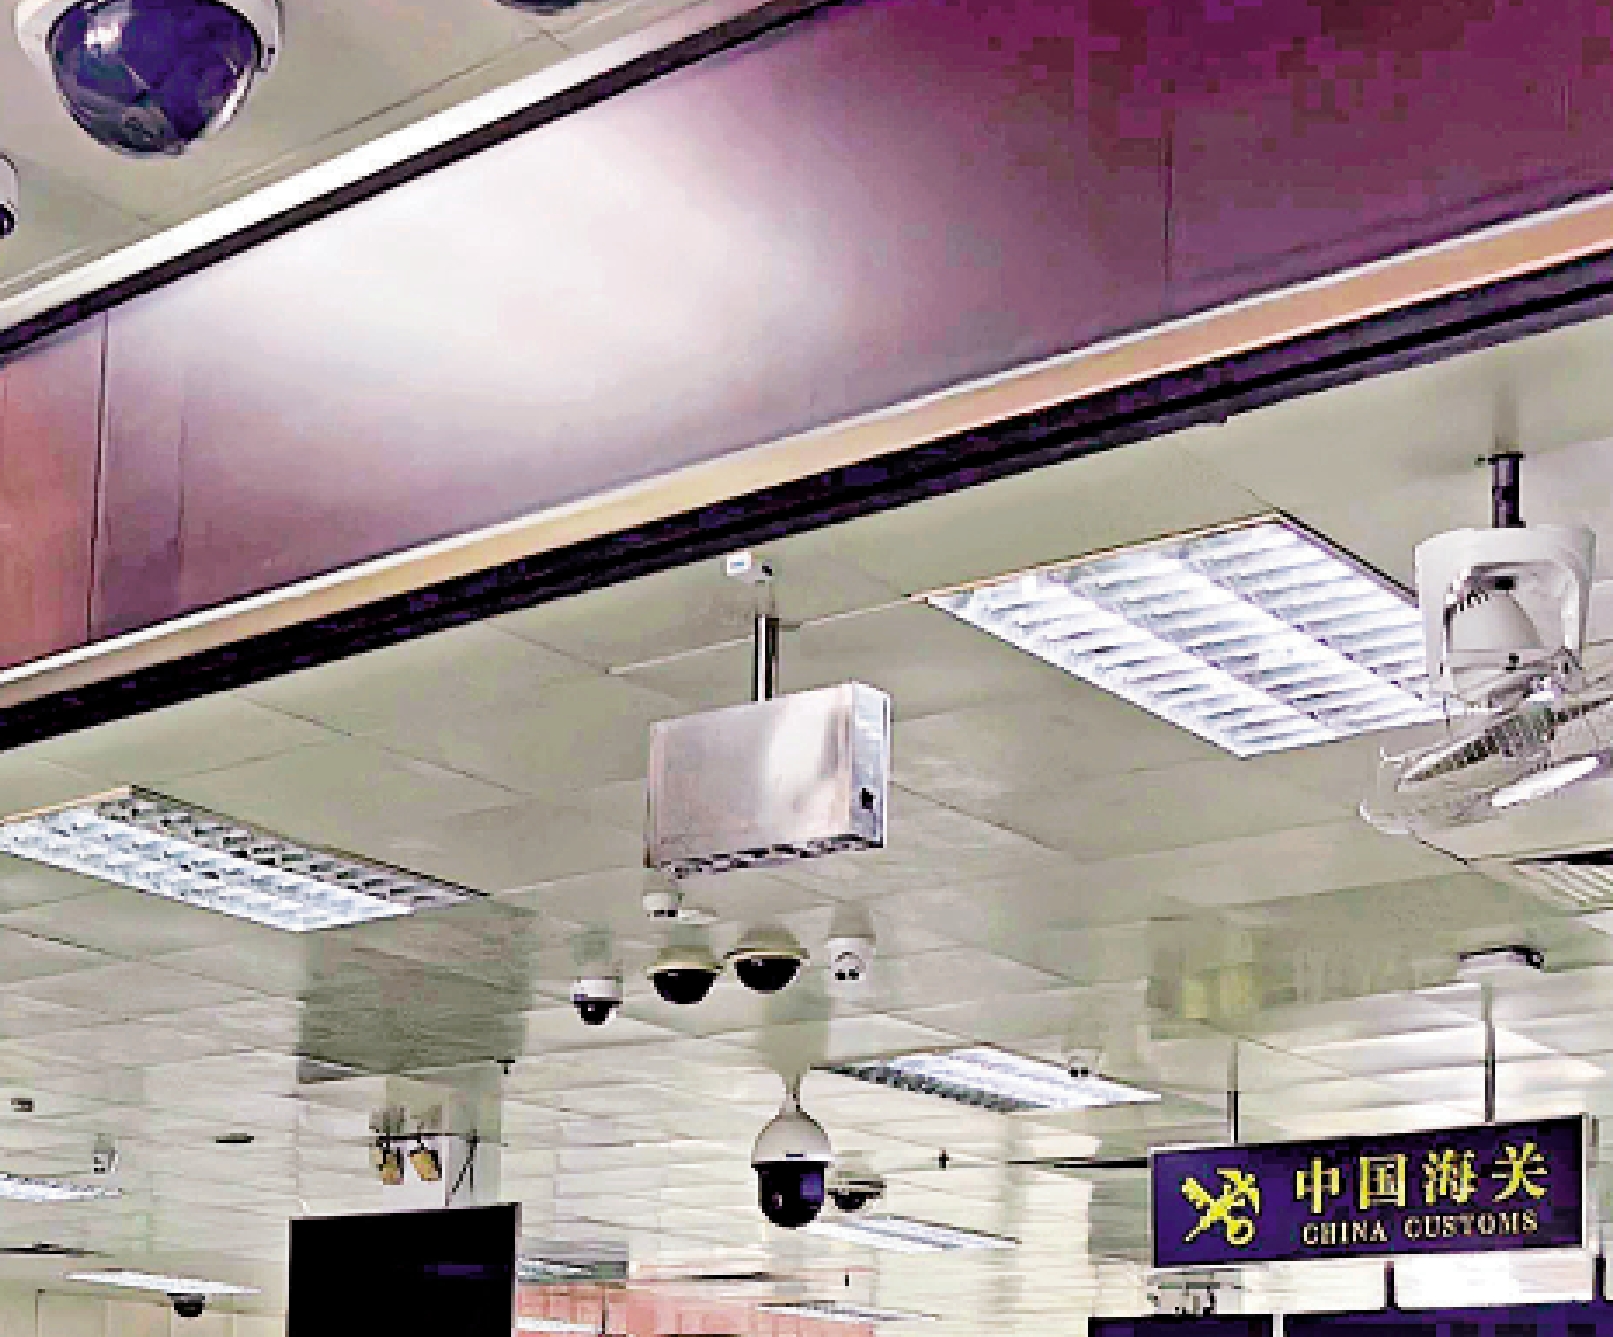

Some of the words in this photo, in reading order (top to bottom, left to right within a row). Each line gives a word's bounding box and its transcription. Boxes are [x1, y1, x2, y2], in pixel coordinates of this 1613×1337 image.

[1296, 1142, 1548, 1213] 中国海关
[1303, 1219, 1387, 1244] CHINA
[1404, 1209, 1538, 1239] CUSTOMS
